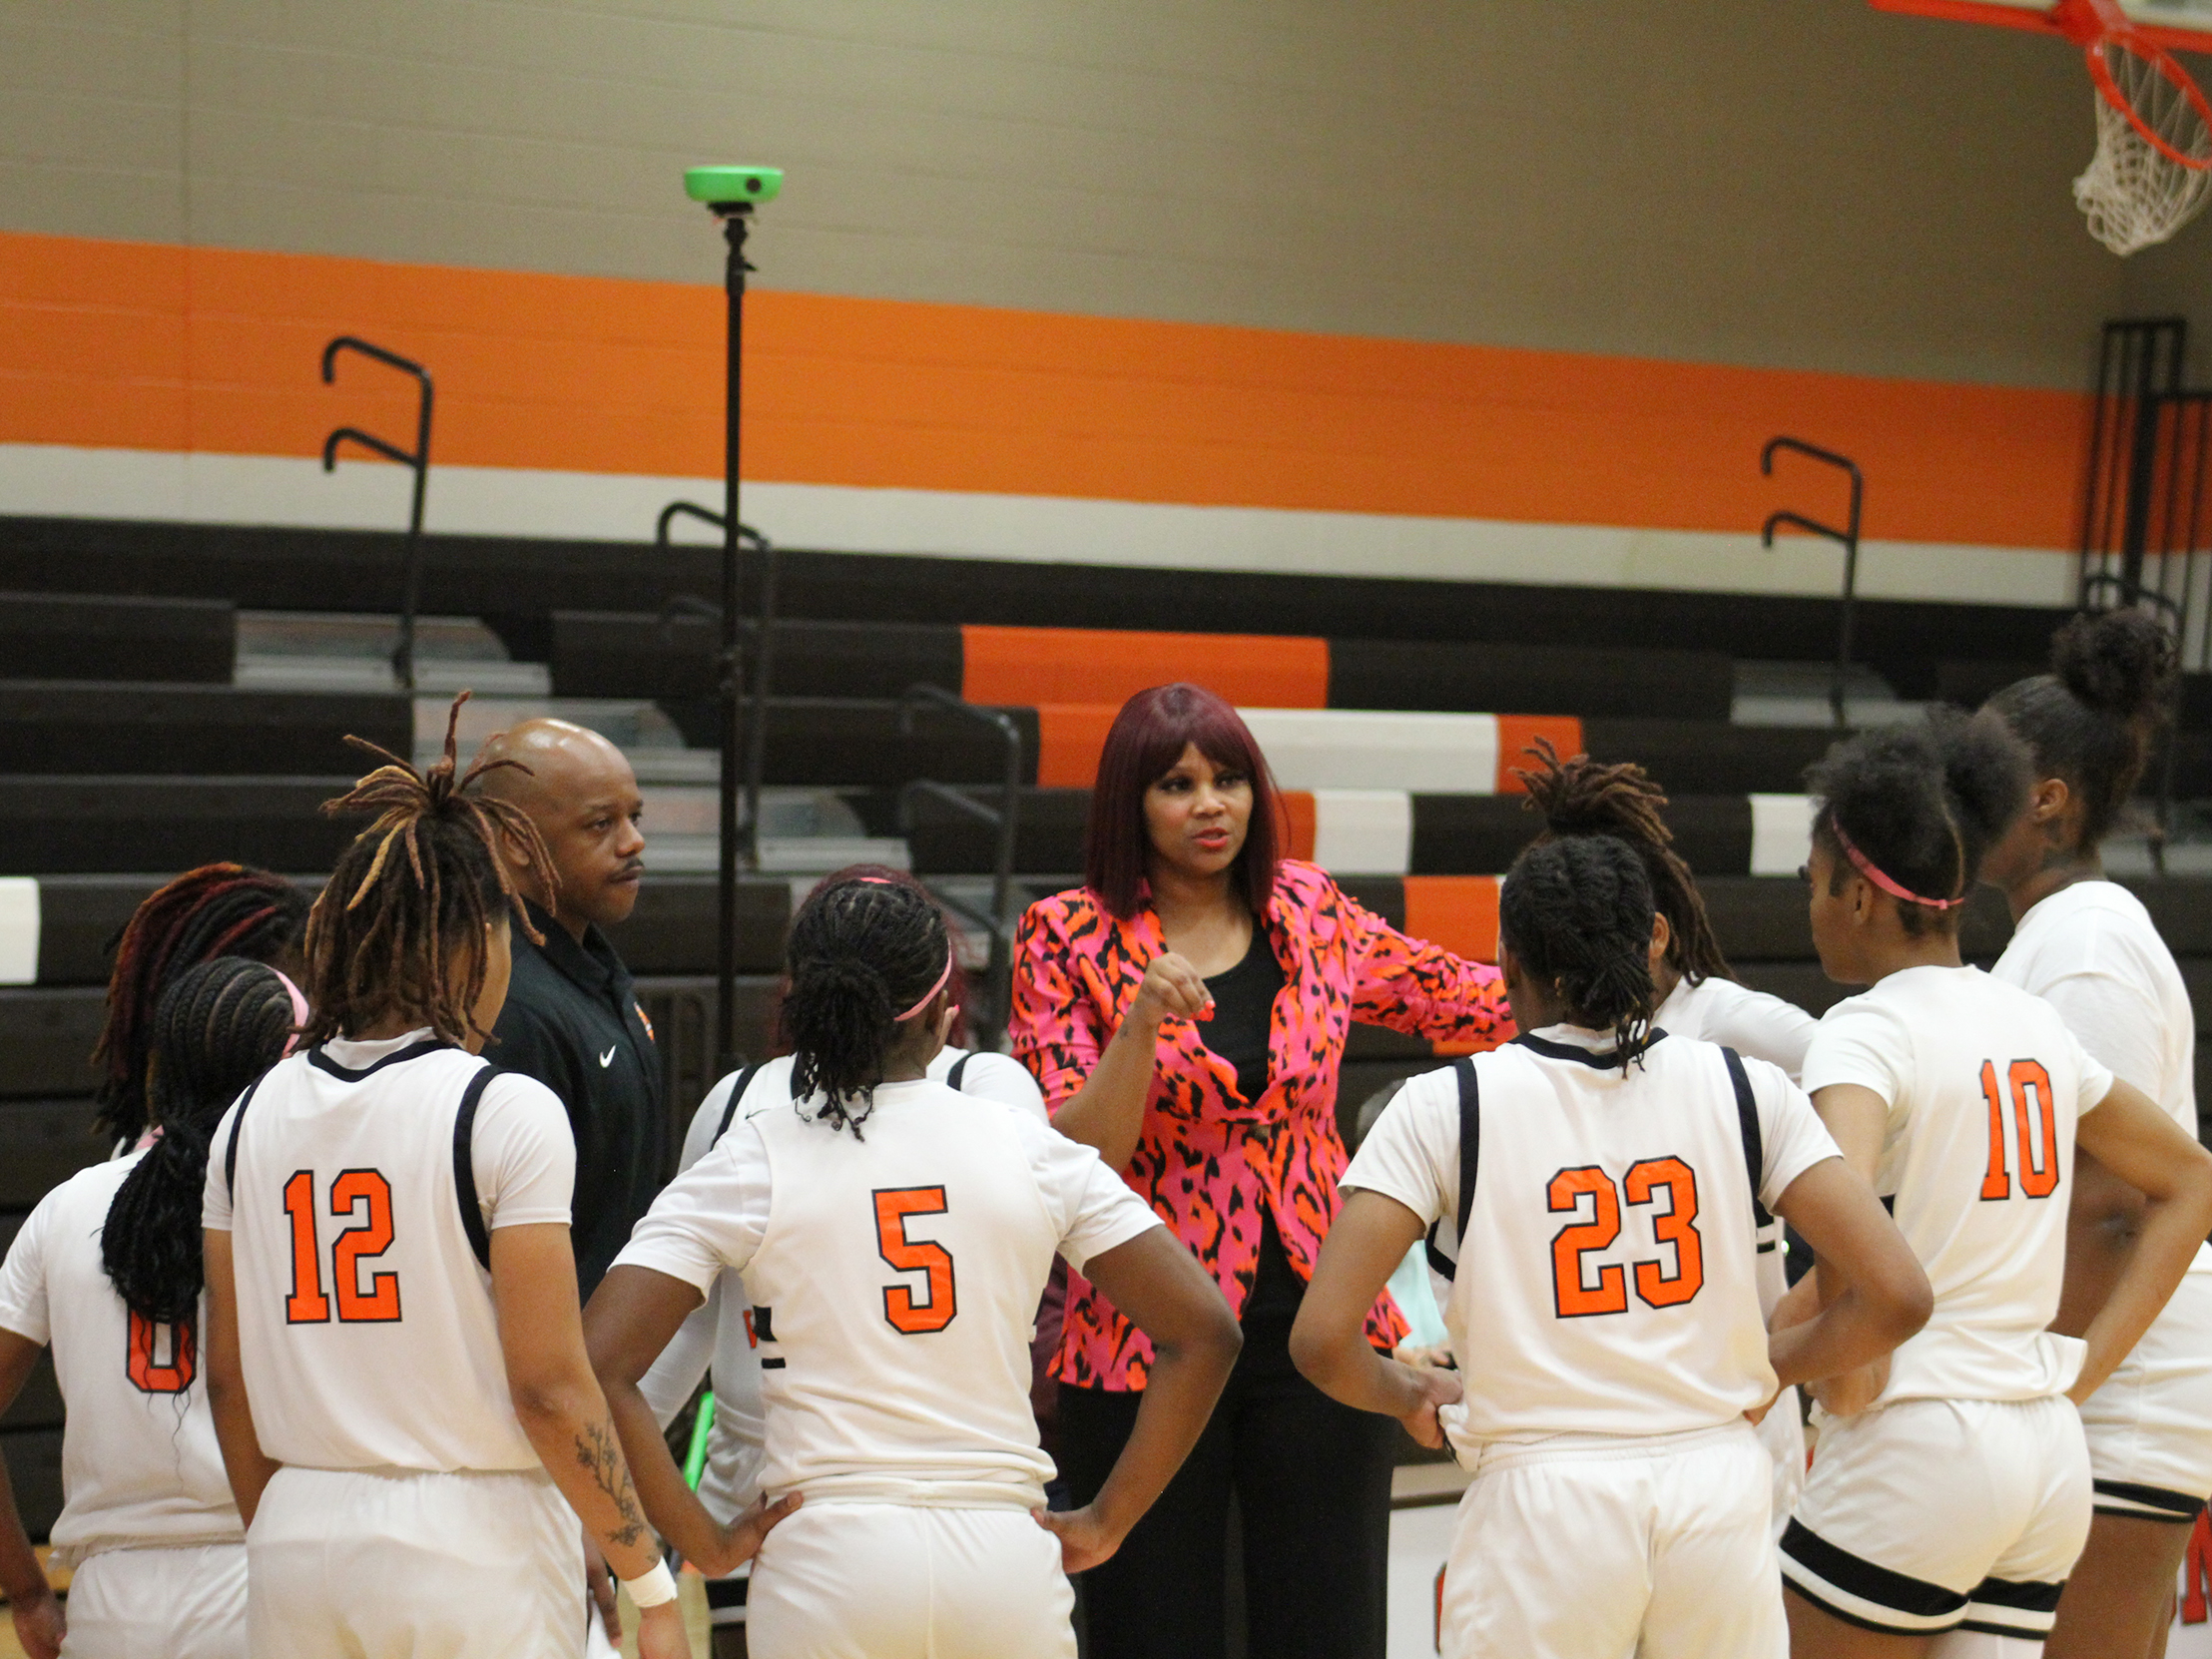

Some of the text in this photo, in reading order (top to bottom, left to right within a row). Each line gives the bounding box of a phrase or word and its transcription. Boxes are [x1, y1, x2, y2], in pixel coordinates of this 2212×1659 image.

[1979, 1058, 2059, 1201] 10
[283, 1168, 401, 1324] 12
[871, 1184, 956, 1335] 5
[1546, 1154, 1704, 1319] 23
